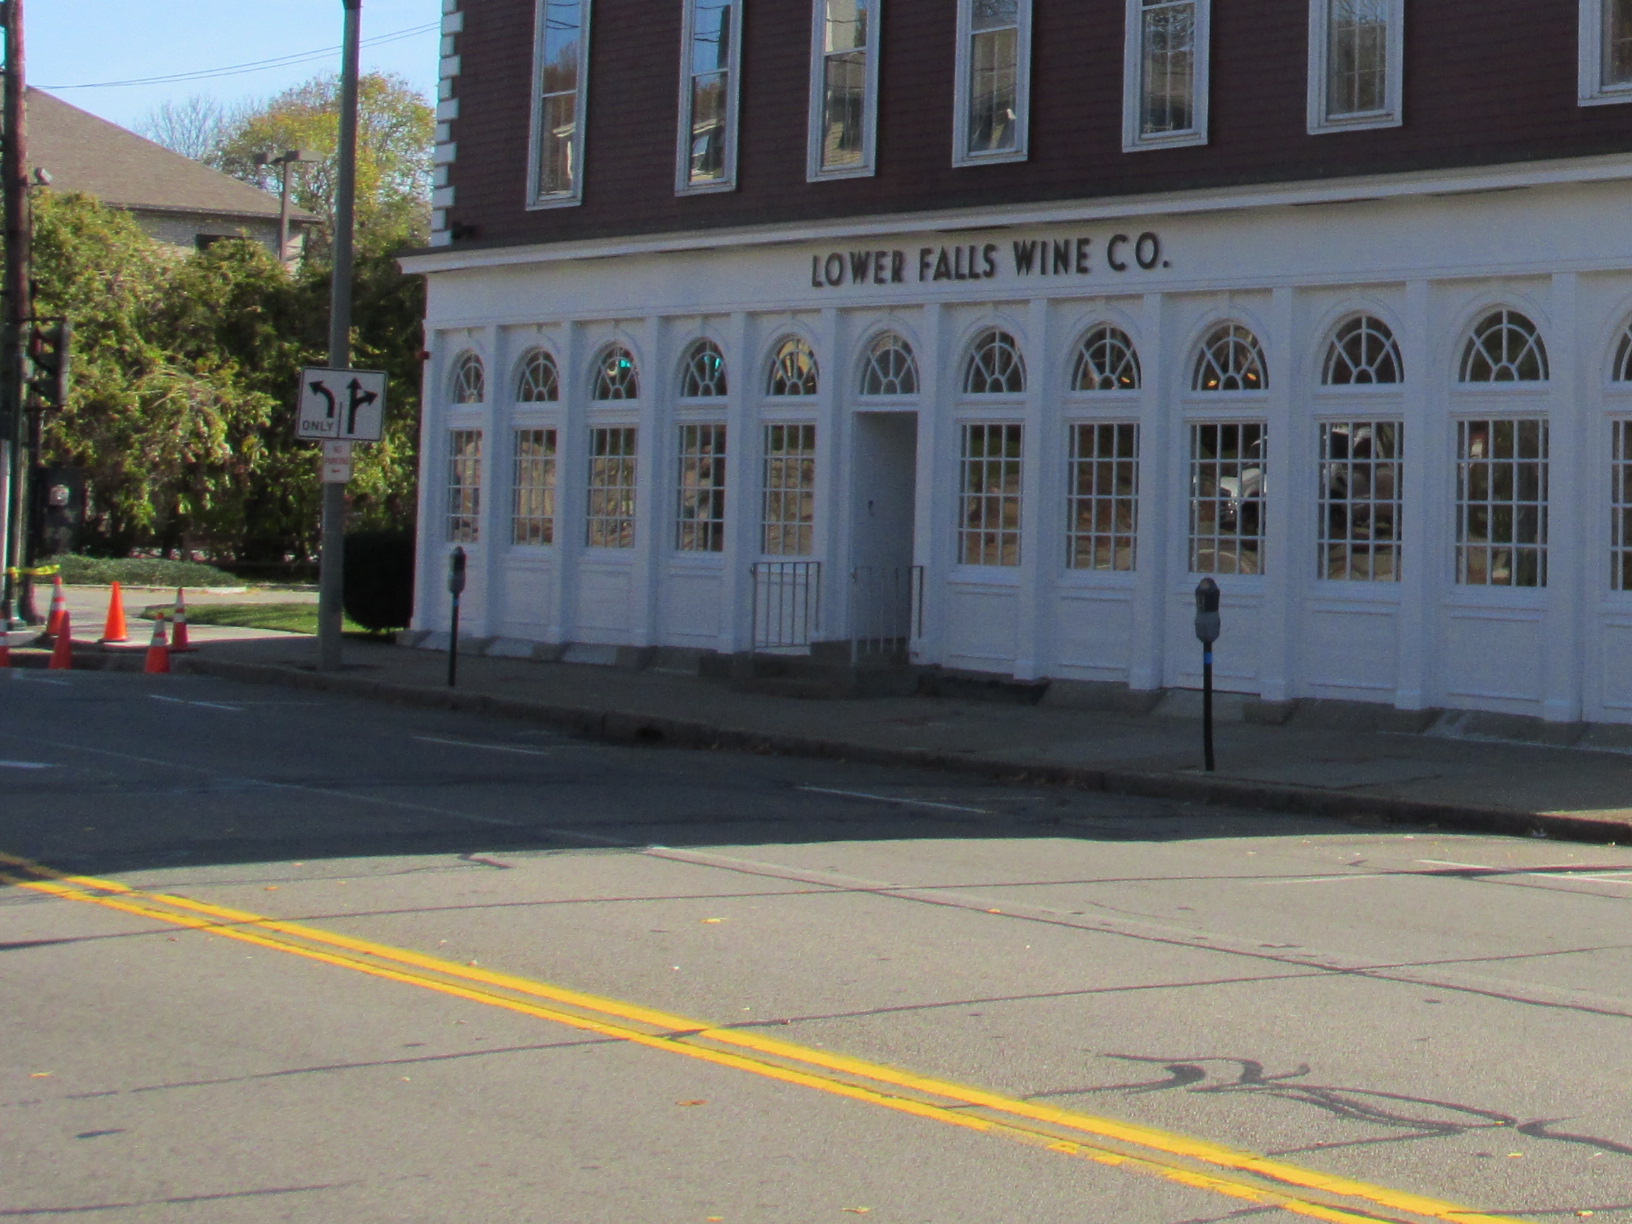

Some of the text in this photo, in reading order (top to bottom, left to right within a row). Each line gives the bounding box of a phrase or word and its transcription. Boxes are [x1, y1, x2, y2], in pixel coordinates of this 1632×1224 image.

[811, 231, 1171, 287] LOWER FALLS WINE CO.
[302, 420, 335, 432] ONLY
